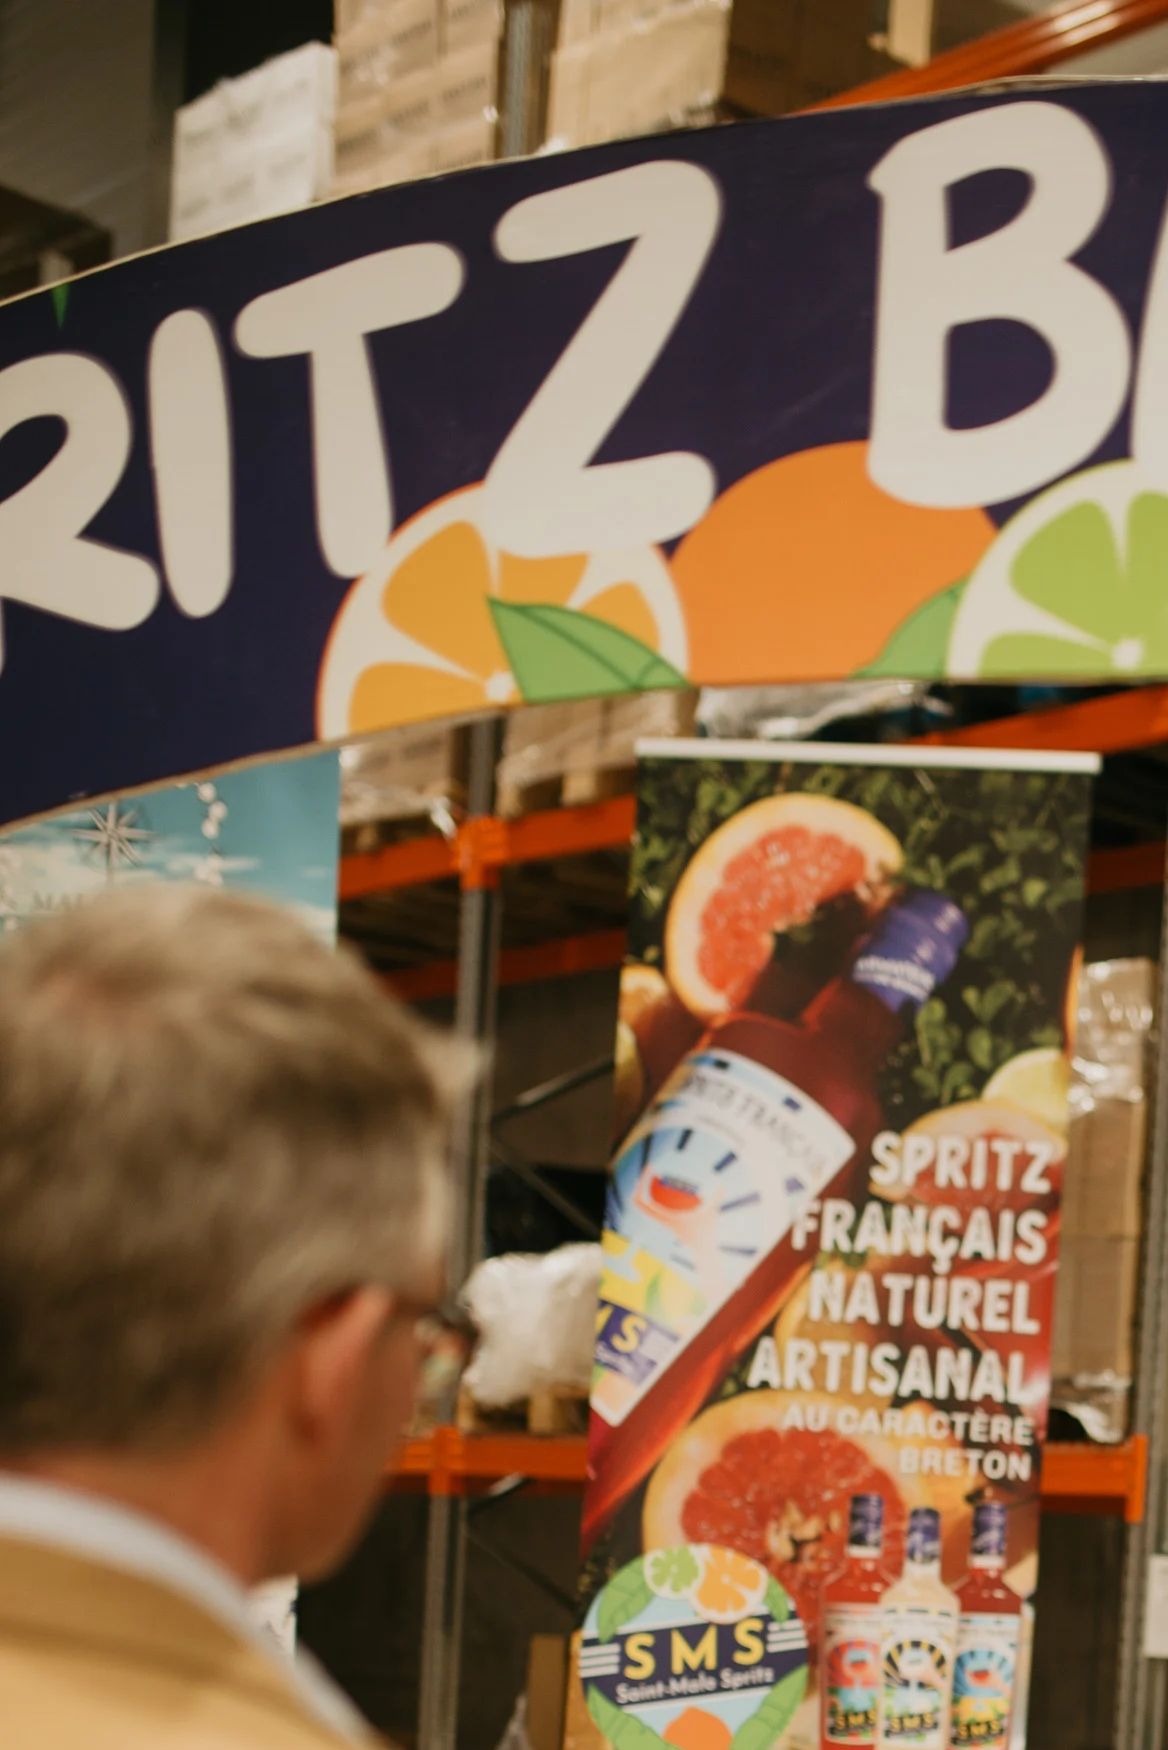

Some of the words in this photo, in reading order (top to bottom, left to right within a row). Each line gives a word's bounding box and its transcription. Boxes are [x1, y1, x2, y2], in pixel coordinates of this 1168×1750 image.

[869, 1129, 1052, 1195] SPRITZ
[790, 1198, 1049, 1274] FRANÇAIS
[807, 1272, 1041, 1335] NATUREL
[746, 1336, 1050, 1406] ARTISANAL
[781, 1403, 828, 1433] AU
[836, 1405, 1036, 1447] CARACTÈRE
[900, 1445, 1032, 1482] BRETON
[624, 1619, 765, 1681] SMS
[615, 1673, 716, 1706] Saint-Malo
[719, 1665, 774, 1696] Spritz
